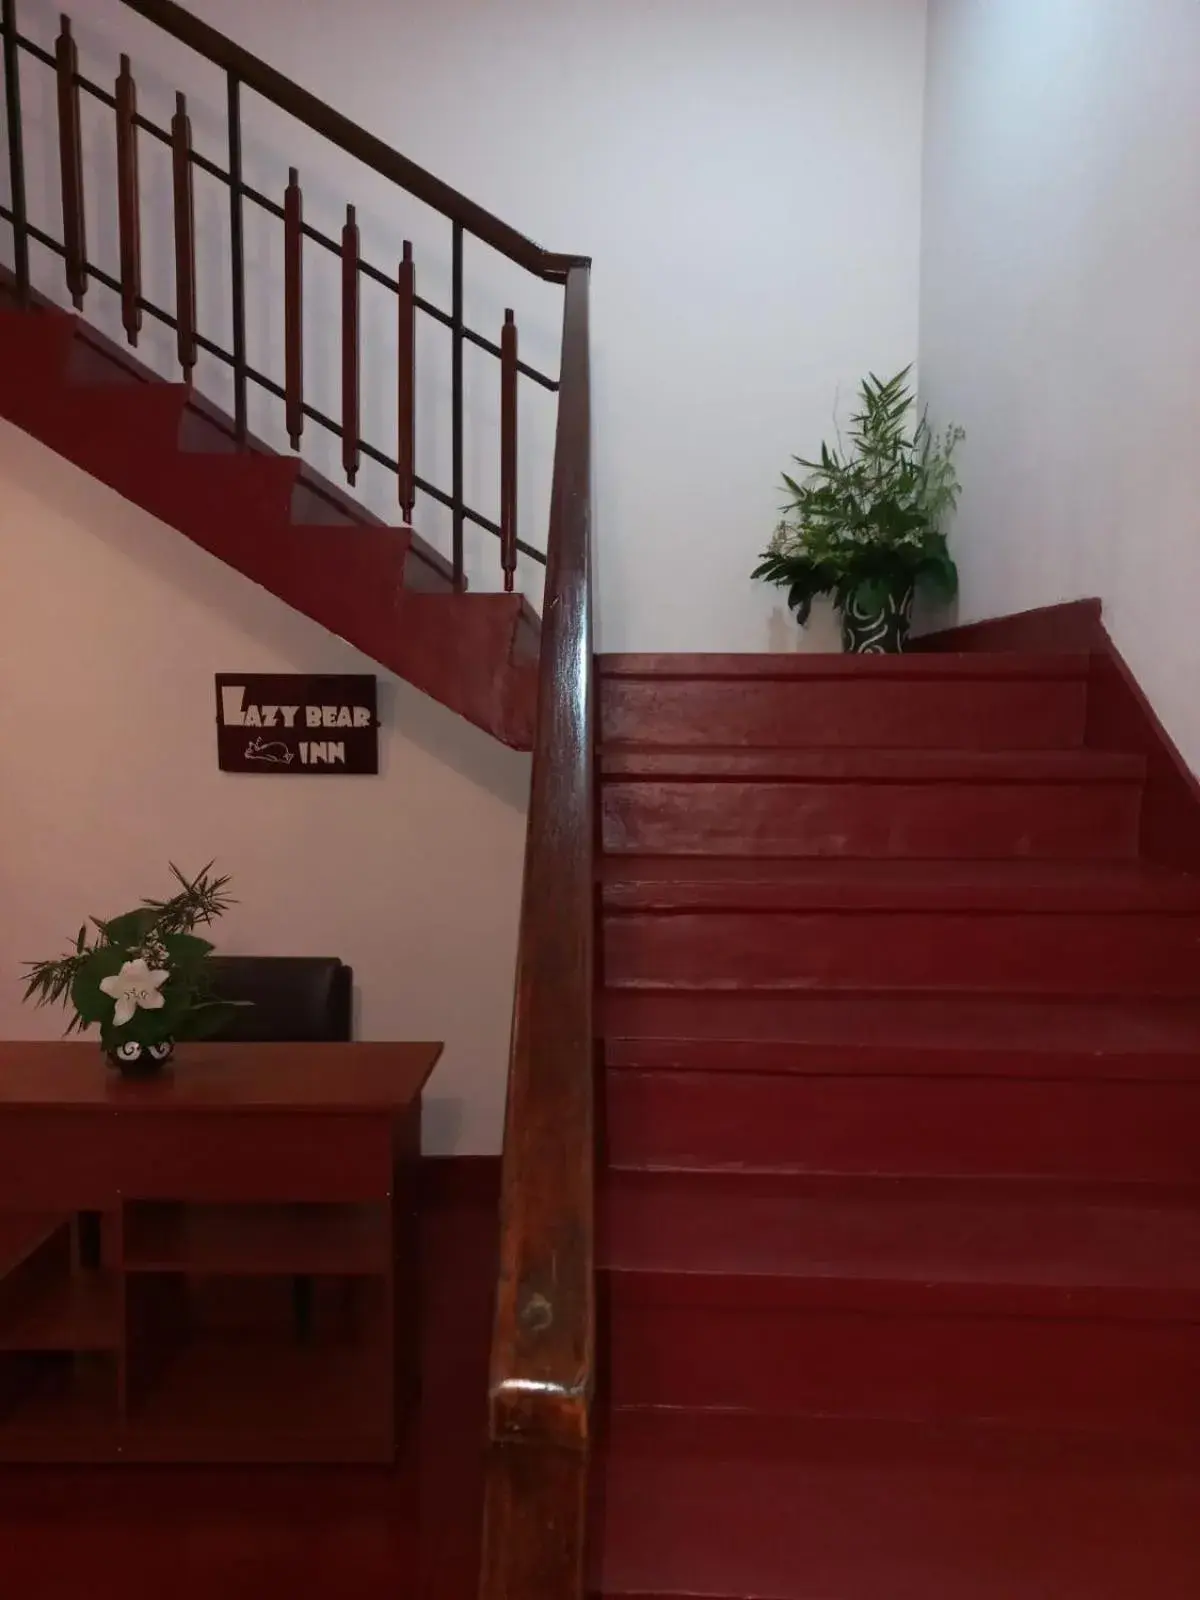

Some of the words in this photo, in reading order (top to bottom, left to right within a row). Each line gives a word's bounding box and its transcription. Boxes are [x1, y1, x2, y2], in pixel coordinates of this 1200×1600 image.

[221, 685, 300, 727] LAZY
[305, 706, 371, 727] BEAR
[298, 741, 346, 764] INN
